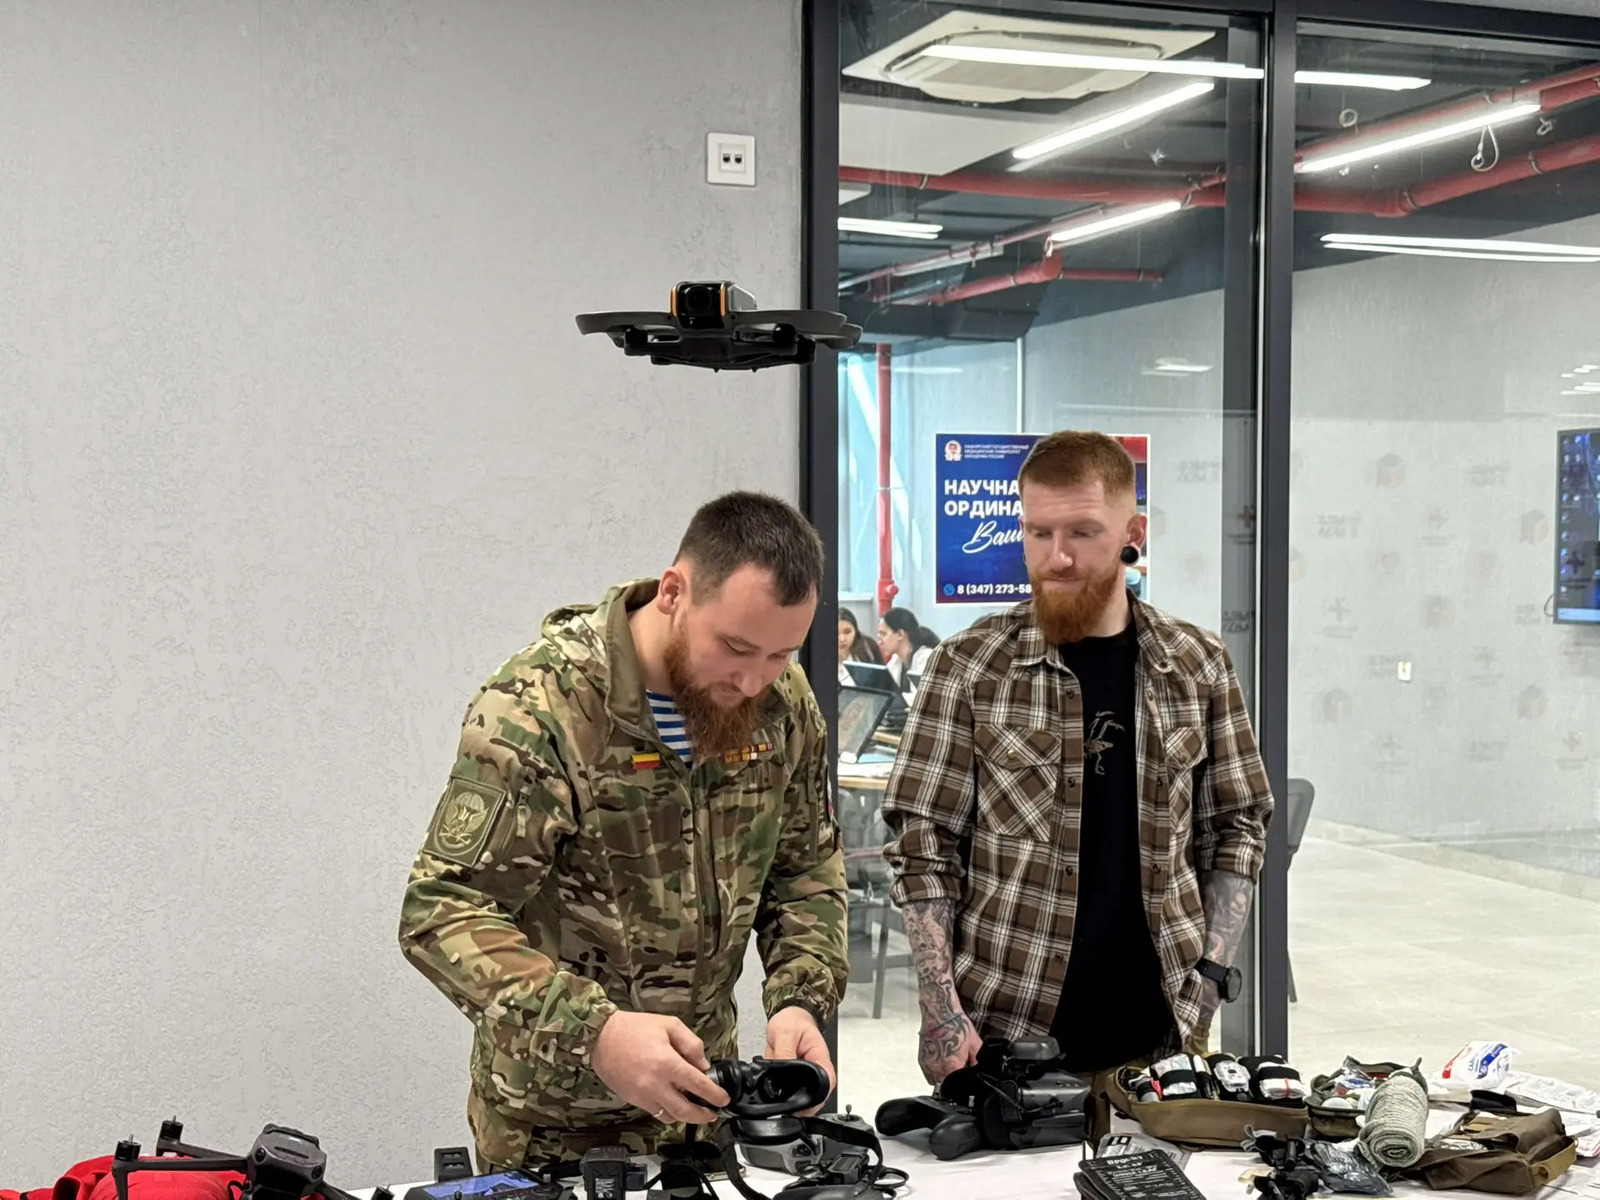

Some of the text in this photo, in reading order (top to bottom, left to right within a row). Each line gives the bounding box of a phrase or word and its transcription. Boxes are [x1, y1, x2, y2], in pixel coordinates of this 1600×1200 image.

[944, 479, 1020, 495] НАУЧНА
[944, 500, 1024, 519] ОРДИНА
[957, 583, 1032, 595] 8 (347) 273-58
